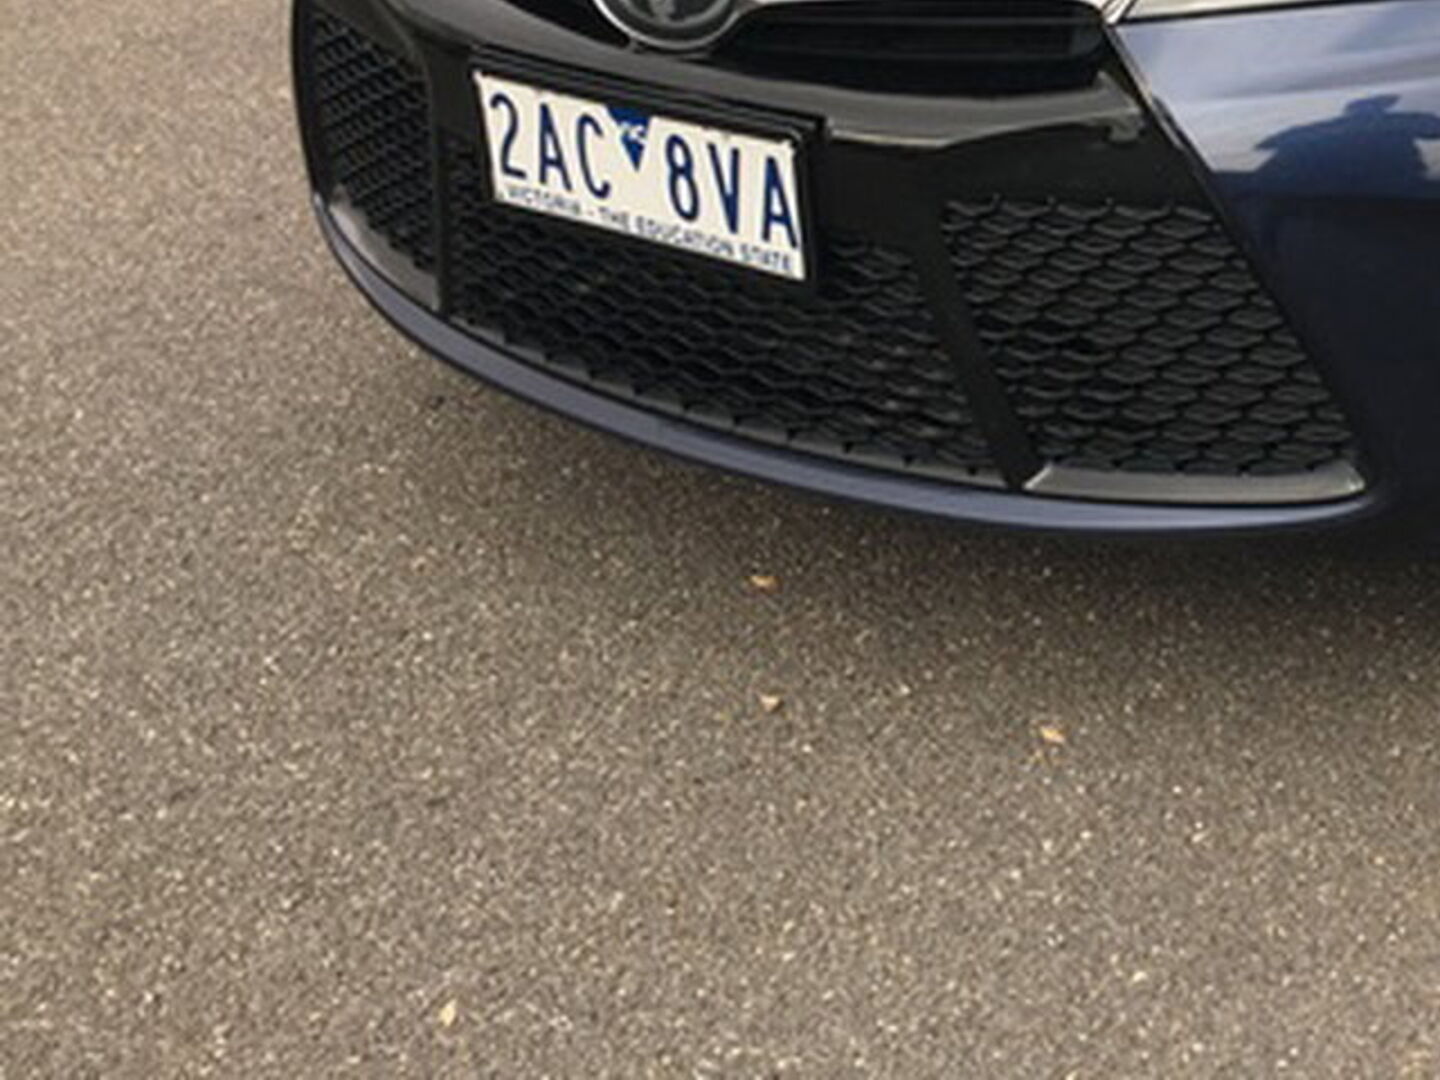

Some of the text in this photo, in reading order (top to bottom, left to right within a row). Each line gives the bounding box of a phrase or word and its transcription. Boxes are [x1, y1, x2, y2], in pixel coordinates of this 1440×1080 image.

[490, 92, 799, 249] 2AC 8VA
[507, 185, 582, 216] VICTORIA
[598, 205, 629, 232] THE
[634, 215, 735, 257] EDUCATION
[739, 242, 792, 271] STATE
